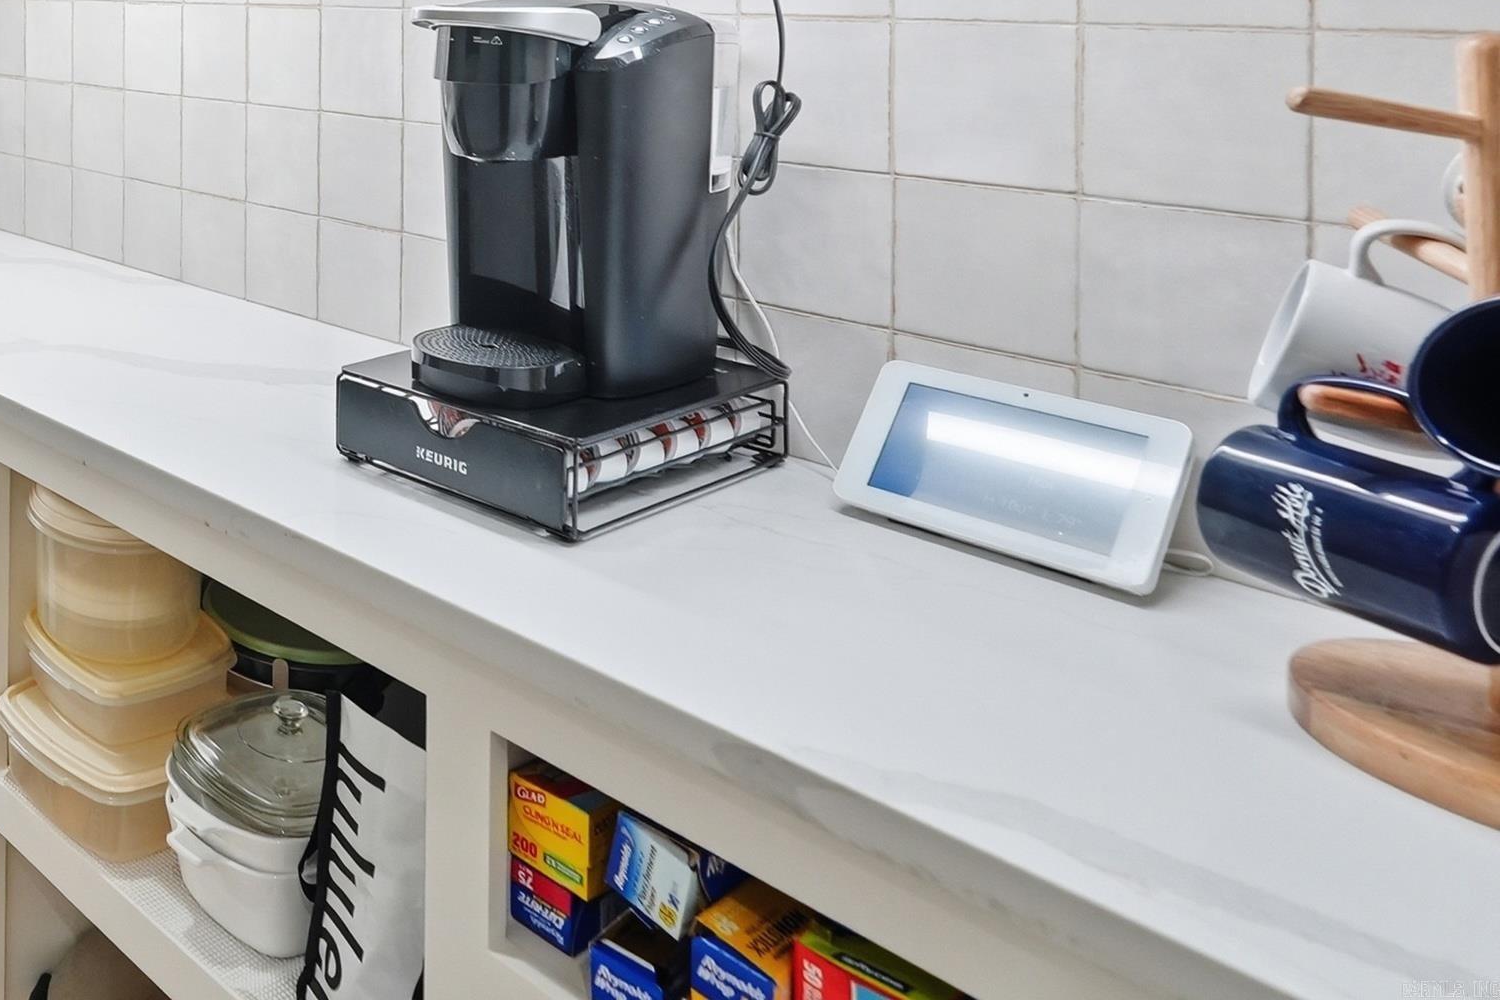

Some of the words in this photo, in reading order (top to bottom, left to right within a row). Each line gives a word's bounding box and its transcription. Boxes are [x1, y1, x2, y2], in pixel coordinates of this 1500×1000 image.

[415, 445, 468, 475] KEURIG
[516, 786, 545, 805] GLAD
[512, 833, 538, 857] 200
[312, 743, 387, 1000] lulule
[518, 868, 534, 891] 75
